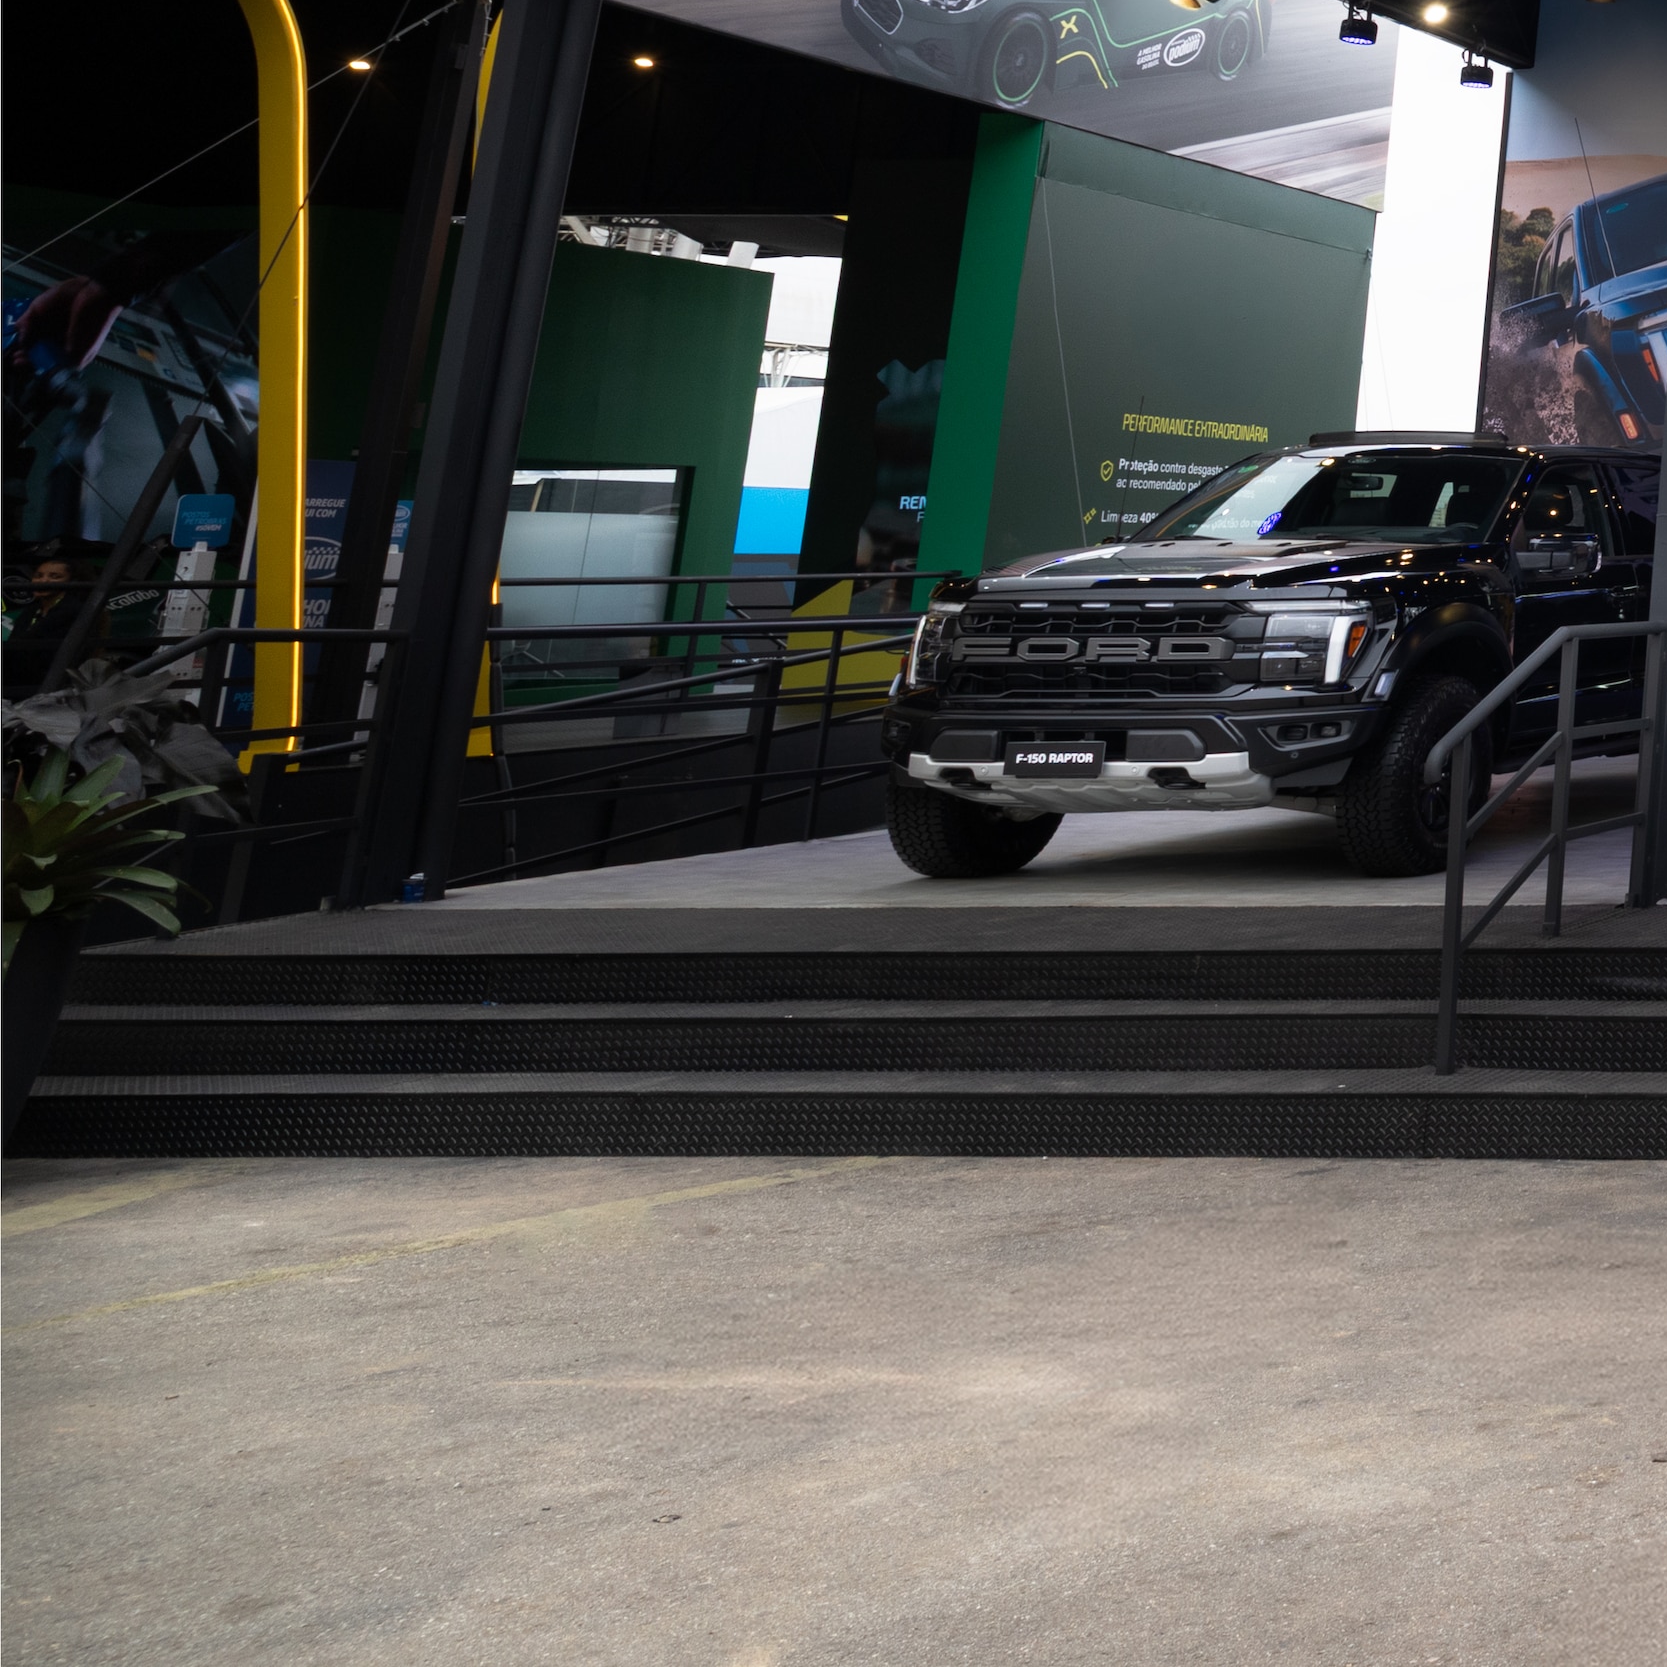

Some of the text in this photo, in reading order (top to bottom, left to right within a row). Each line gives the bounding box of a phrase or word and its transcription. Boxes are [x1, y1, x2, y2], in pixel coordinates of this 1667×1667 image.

[1122, 413, 1195, 437] PERFORMANCE
[1119, 458, 1159, 475] Proteção
[1160, 463, 1186, 474] contra
[1129, 478, 1187, 492] recomendado
[304, 498, 346, 508] ARREGUE
[316, 509, 336, 518] COM
[1101, 510, 1138, 524] Limeza
[951, 637, 1236, 662] FORD
[1015, 752, 1094, 764] F-150 RAPTOR
